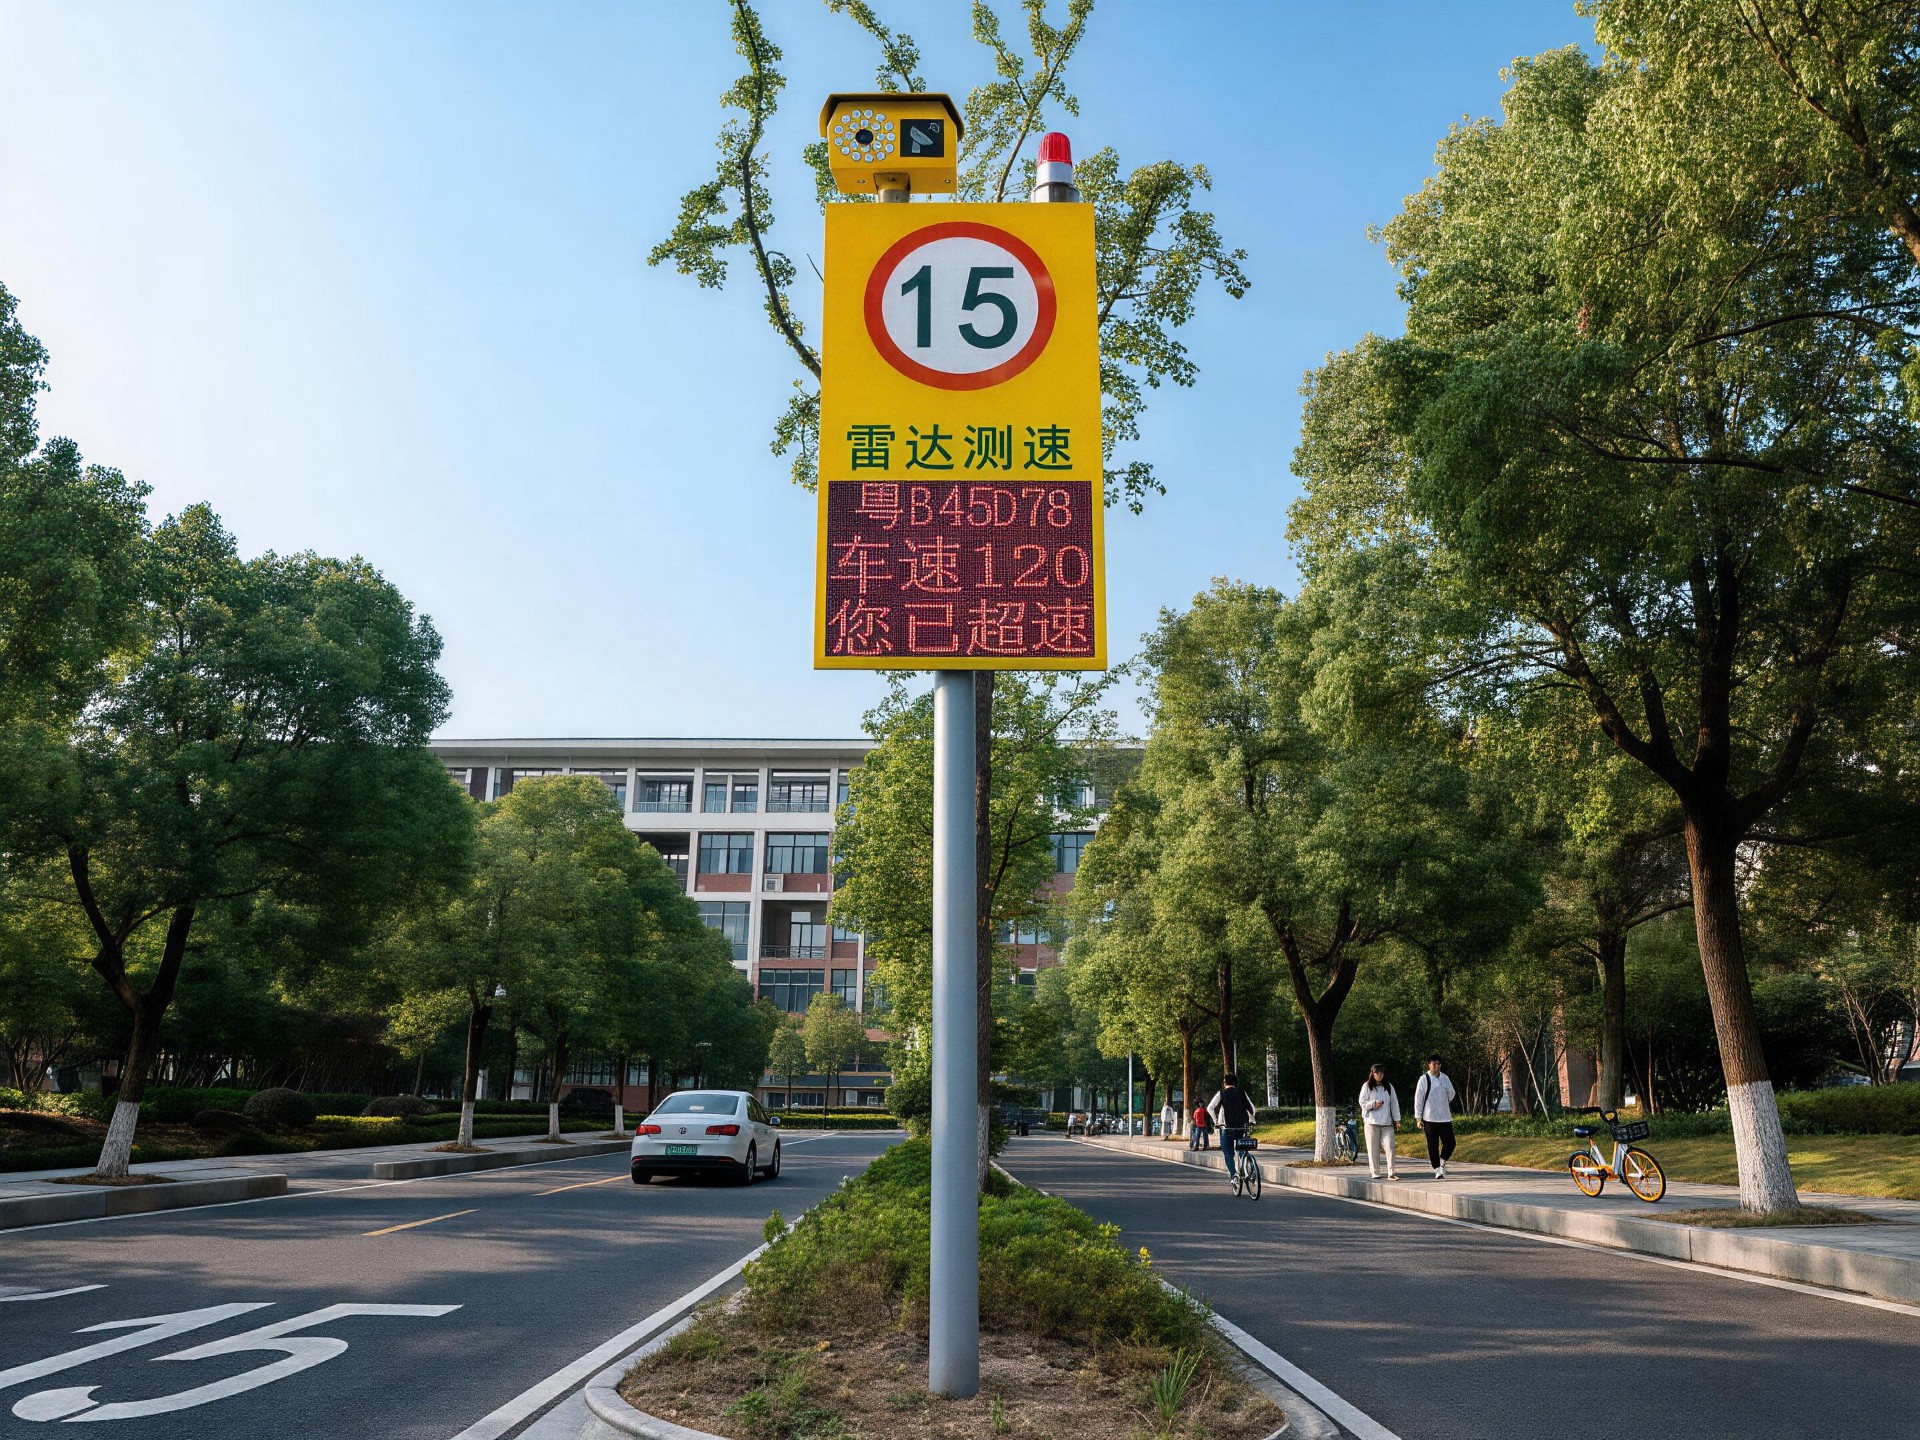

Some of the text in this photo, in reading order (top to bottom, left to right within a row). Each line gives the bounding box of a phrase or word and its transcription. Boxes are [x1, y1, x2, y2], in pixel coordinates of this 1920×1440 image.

[901, 265, 1018, 349] 15
[846, 424, 1073, 471] 雷达测速
[828, 597, 1092, 656] 您已超速
[0, 1302, 464, 1423] 15
